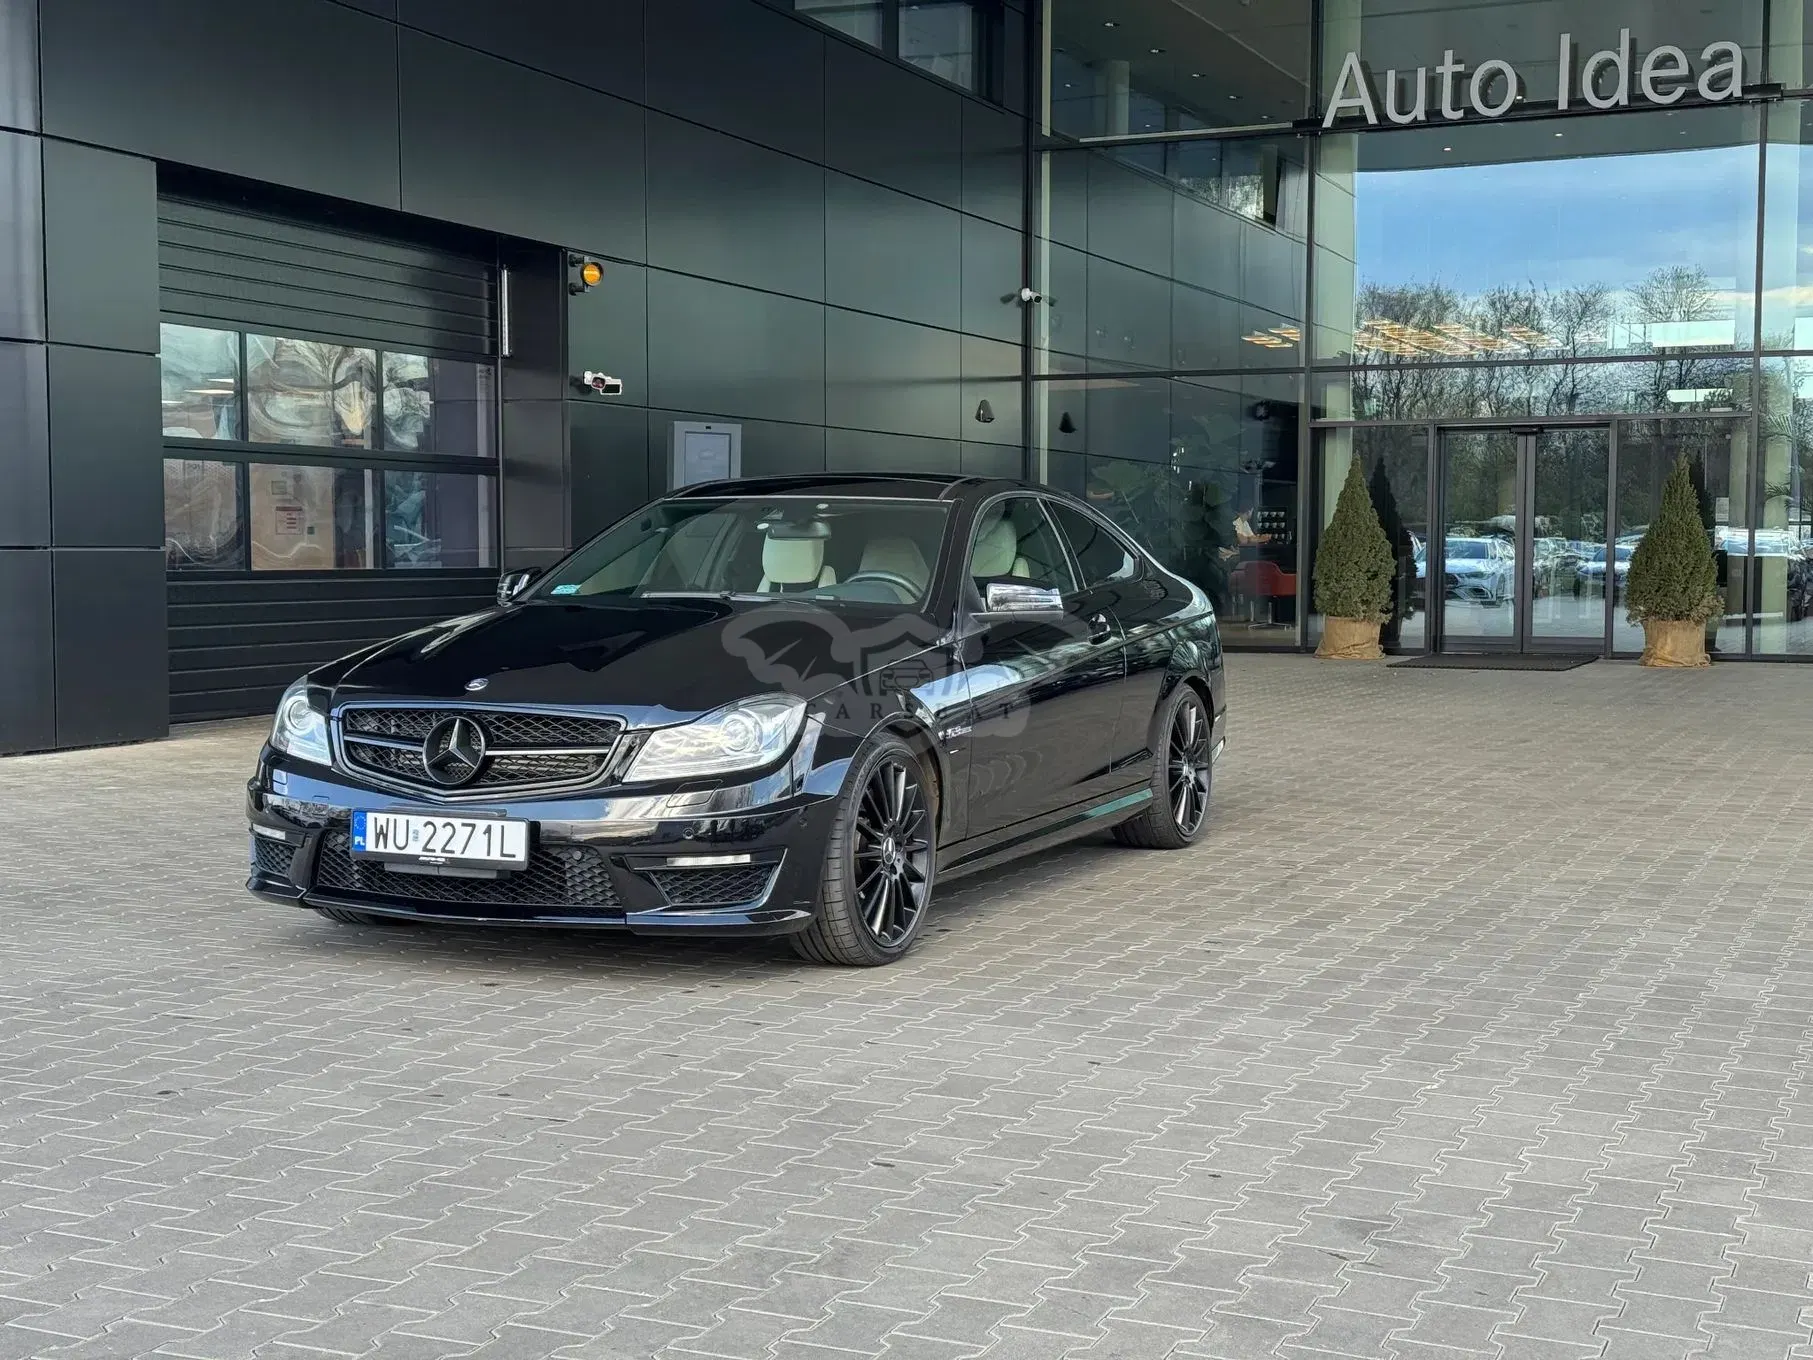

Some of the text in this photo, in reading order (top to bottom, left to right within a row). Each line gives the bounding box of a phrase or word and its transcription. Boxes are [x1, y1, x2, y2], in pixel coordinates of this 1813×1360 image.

[1322, 27, 1744, 128] Auto Idea
[354, 836, 366, 846] PL
[374, 816, 517, 858] WU 2271L
